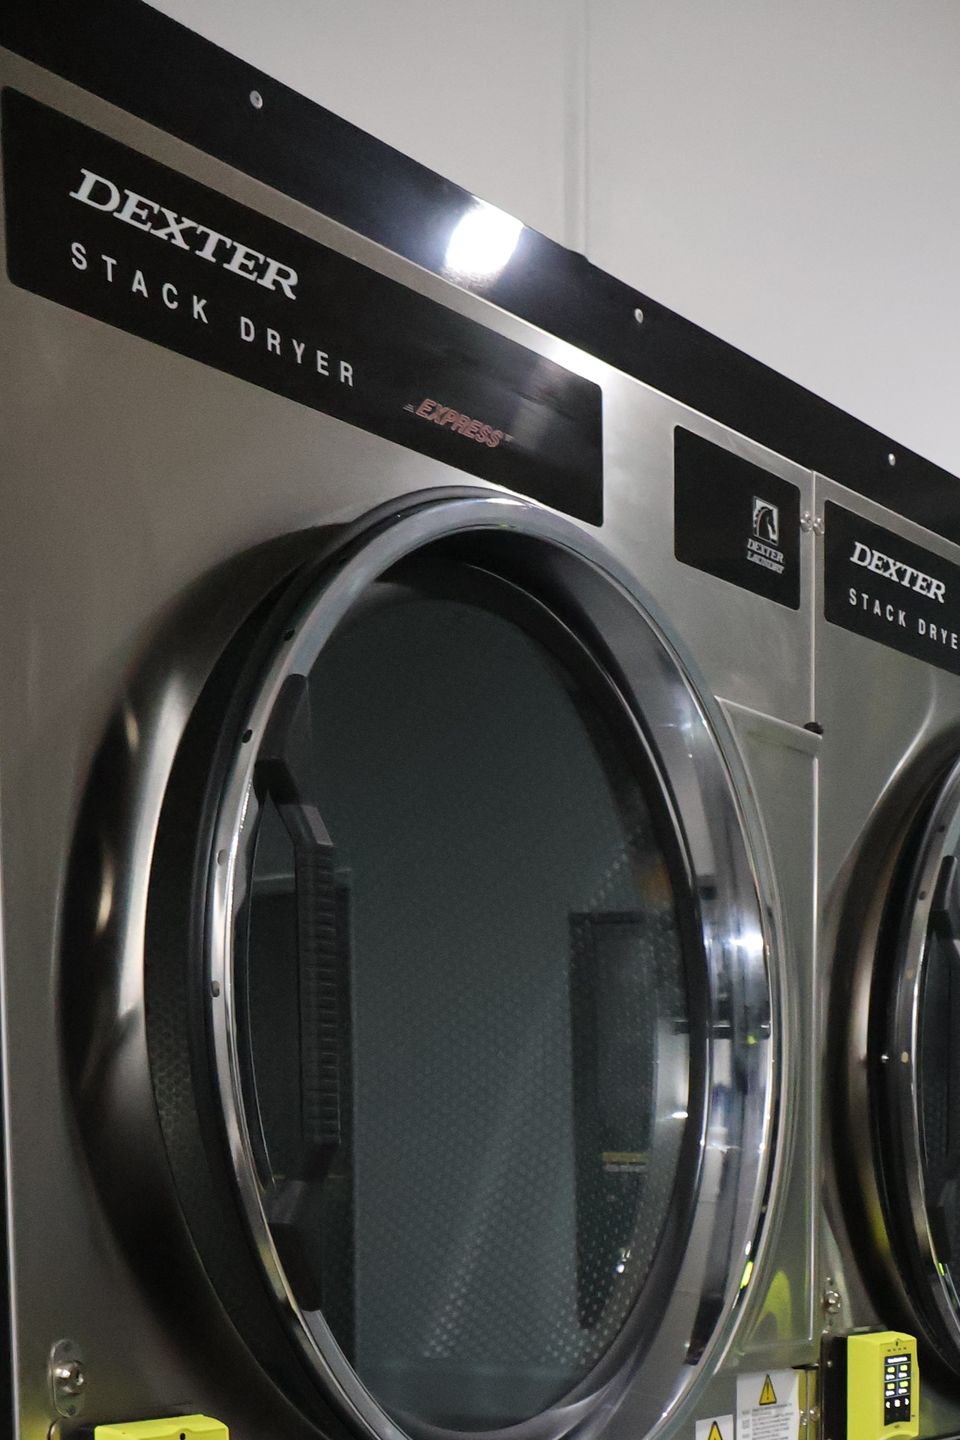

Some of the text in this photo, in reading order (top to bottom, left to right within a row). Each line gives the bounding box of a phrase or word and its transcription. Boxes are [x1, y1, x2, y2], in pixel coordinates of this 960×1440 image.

[69, 168, 299, 300] DEXTER
[71, 241, 355, 387] STACK DRYER
[415, 398, 505, 448] EXPRESS
[849, 540, 947, 603] DEXTER
[848, 588, 908, 628] STACK
